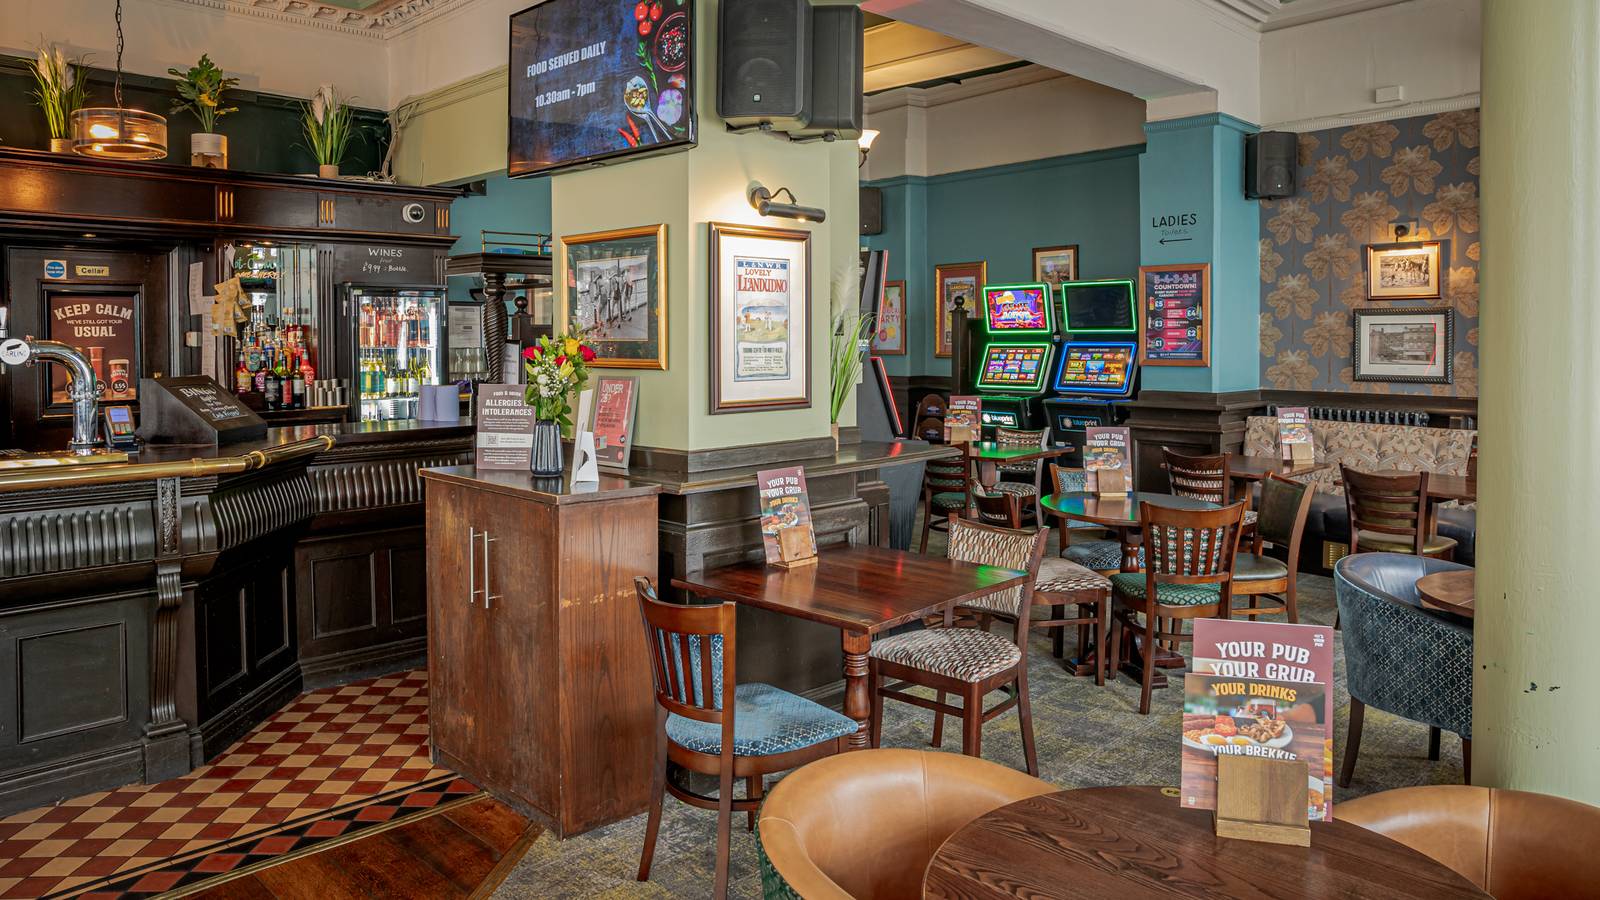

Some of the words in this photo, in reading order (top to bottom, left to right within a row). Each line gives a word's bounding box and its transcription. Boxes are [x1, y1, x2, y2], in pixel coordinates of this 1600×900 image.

[527, 61, 548, 77] FOOD
[548, 50, 579, 70] SERVED
[581, 41, 607, 60] DAILY
[535, 88, 570, 108] 10.30am
[576, 81, 596, 97] 7pm
[1152, 213, 1198, 228] LADIES
[368, 247, 403, 257] WINES
[81, 267, 105, 275] Cellar
[737, 274, 788, 293] LLANDUDNO
[54, 304, 91, 320] KEEP
[95, 303, 133, 320] CALM
[74, 326, 116, 338] USUAL
[485, 398, 522, 407] ALLERGIES
[482, 407, 532, 416] INTOLERANCES
[991, 414, 1013, 423] blueprint
[1072, 418, 1097, 427] blueprint
[766, 478, 784, 489] YOUR
[786, 477, 799, 485] PUB
[767, 487, 784, 498] YOUR
[1215, 641, 1265, 659] YOUR
[1272, 643, 1311, 665] PUB
[1210, 661, 1260, 678] YOUR
[1265, 662, 1316, 683] GRUB
[1211, 682, 1246, 696] YOUR
[1249, 683, 1297, 702] DRINKS
[1210, 744, 1243, 756] YOUR
